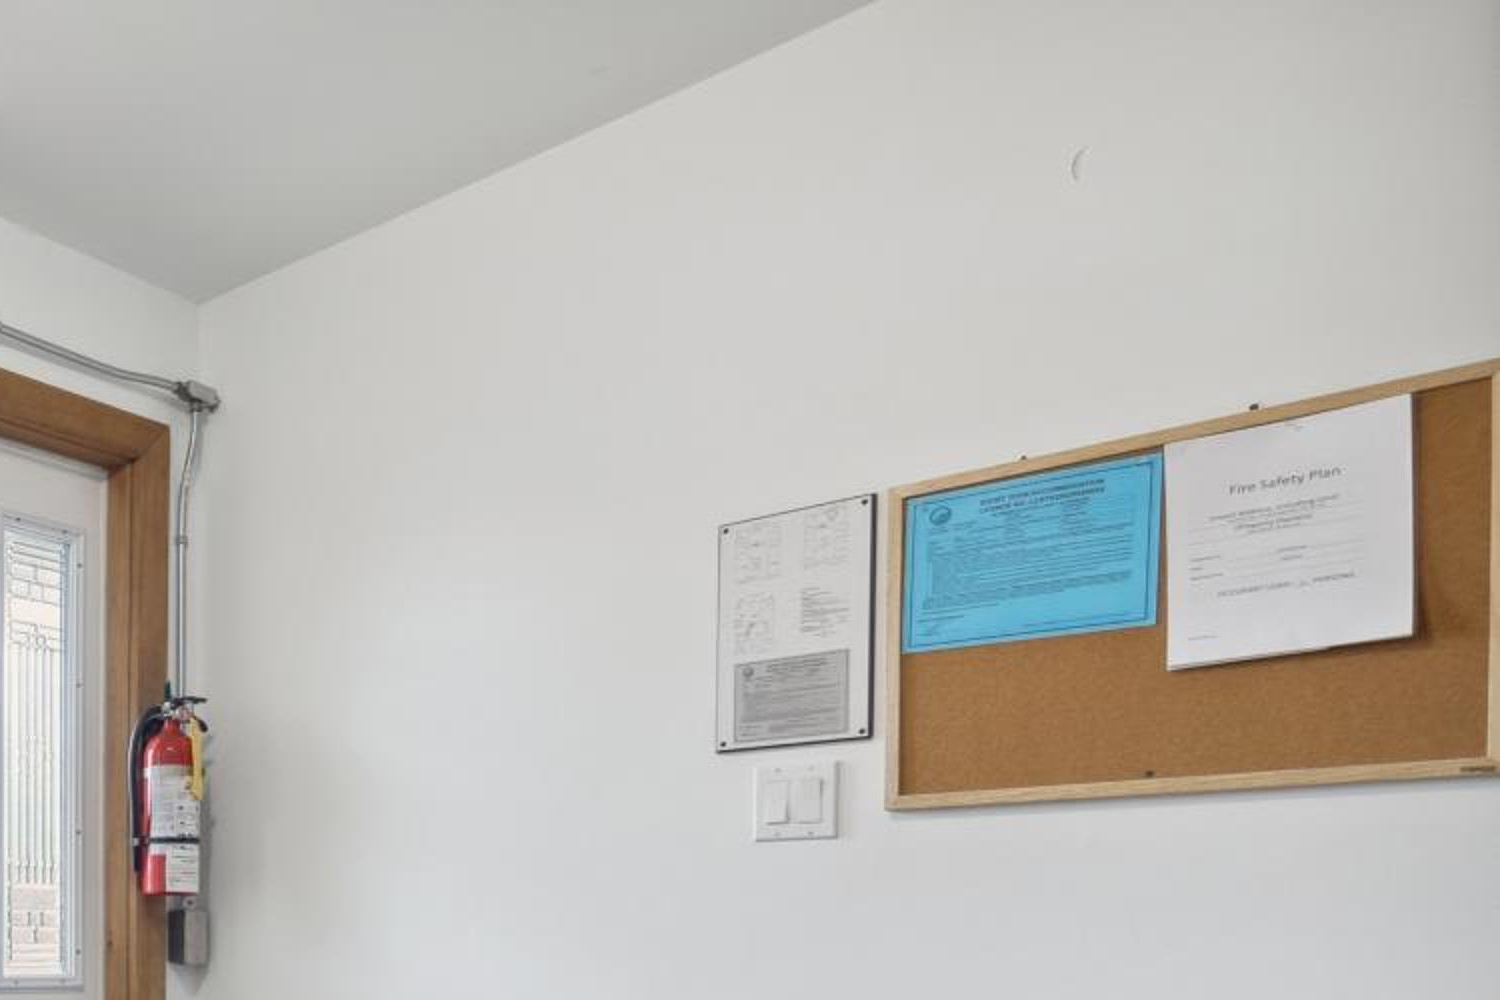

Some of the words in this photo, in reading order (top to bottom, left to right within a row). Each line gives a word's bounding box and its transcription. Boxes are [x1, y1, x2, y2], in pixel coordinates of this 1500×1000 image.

[1228, 482, 1257, 496] Fire
[1260, 472, 1305, 490] Safety
[1308, 466, 1343, 481] Plan
